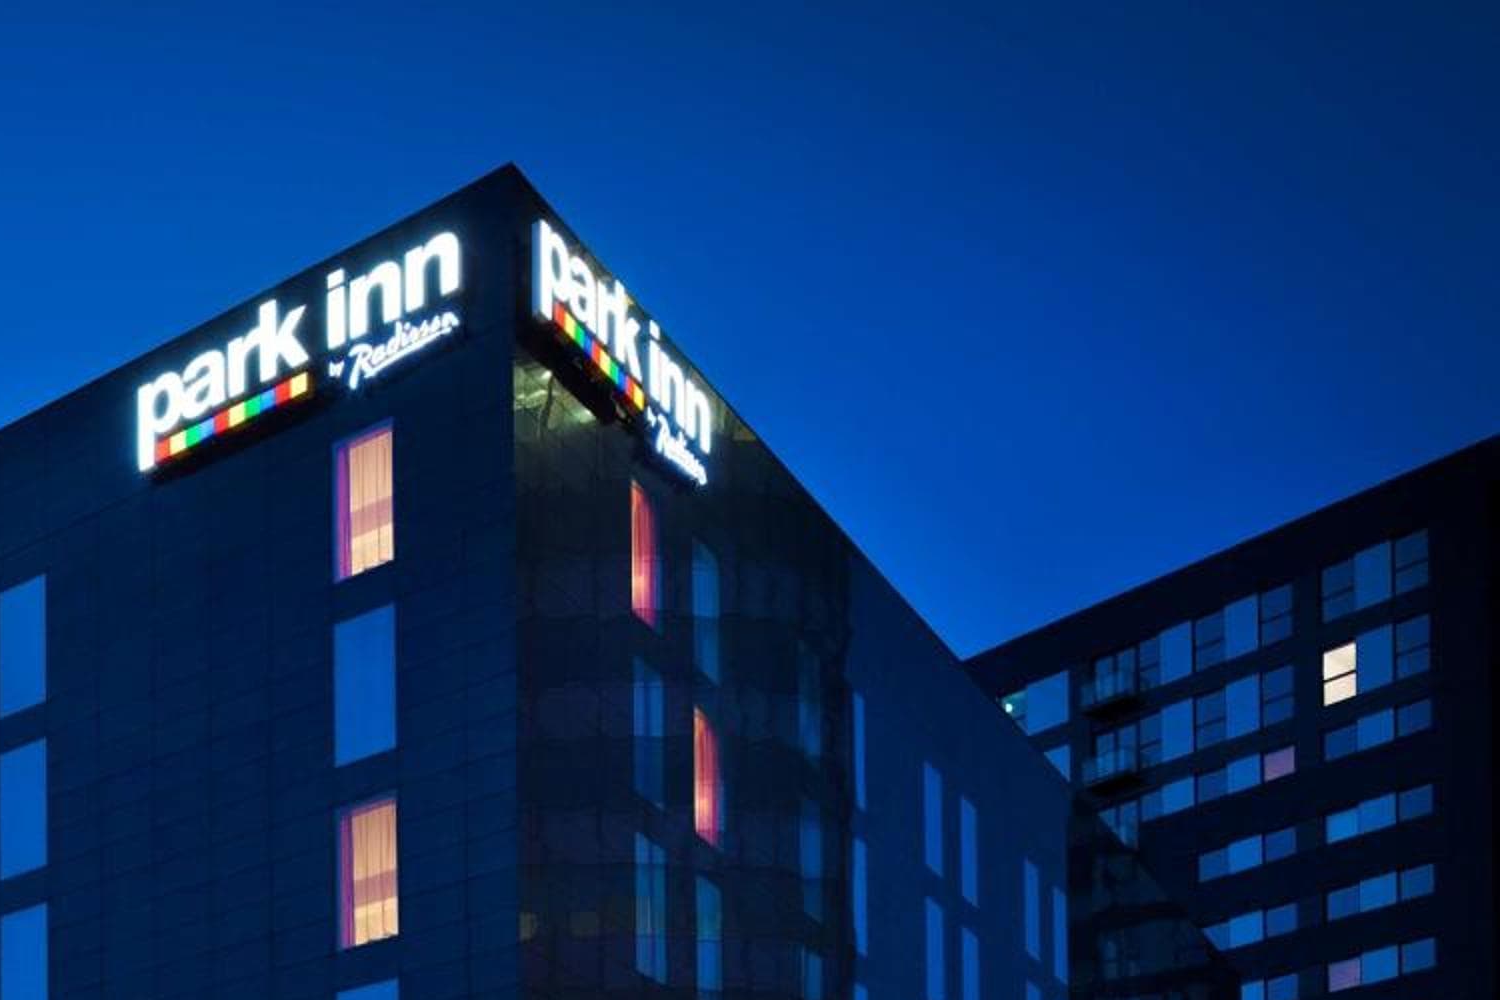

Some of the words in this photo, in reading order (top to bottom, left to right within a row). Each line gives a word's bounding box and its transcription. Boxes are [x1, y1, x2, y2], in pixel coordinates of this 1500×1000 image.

[137, 298, 310, 473] park
[326, 231, 461, 350] inn
[347, 310, 461, 391] Radisson
[533, 218, 643, 383] park
[648, 319, 711, 454] inn
